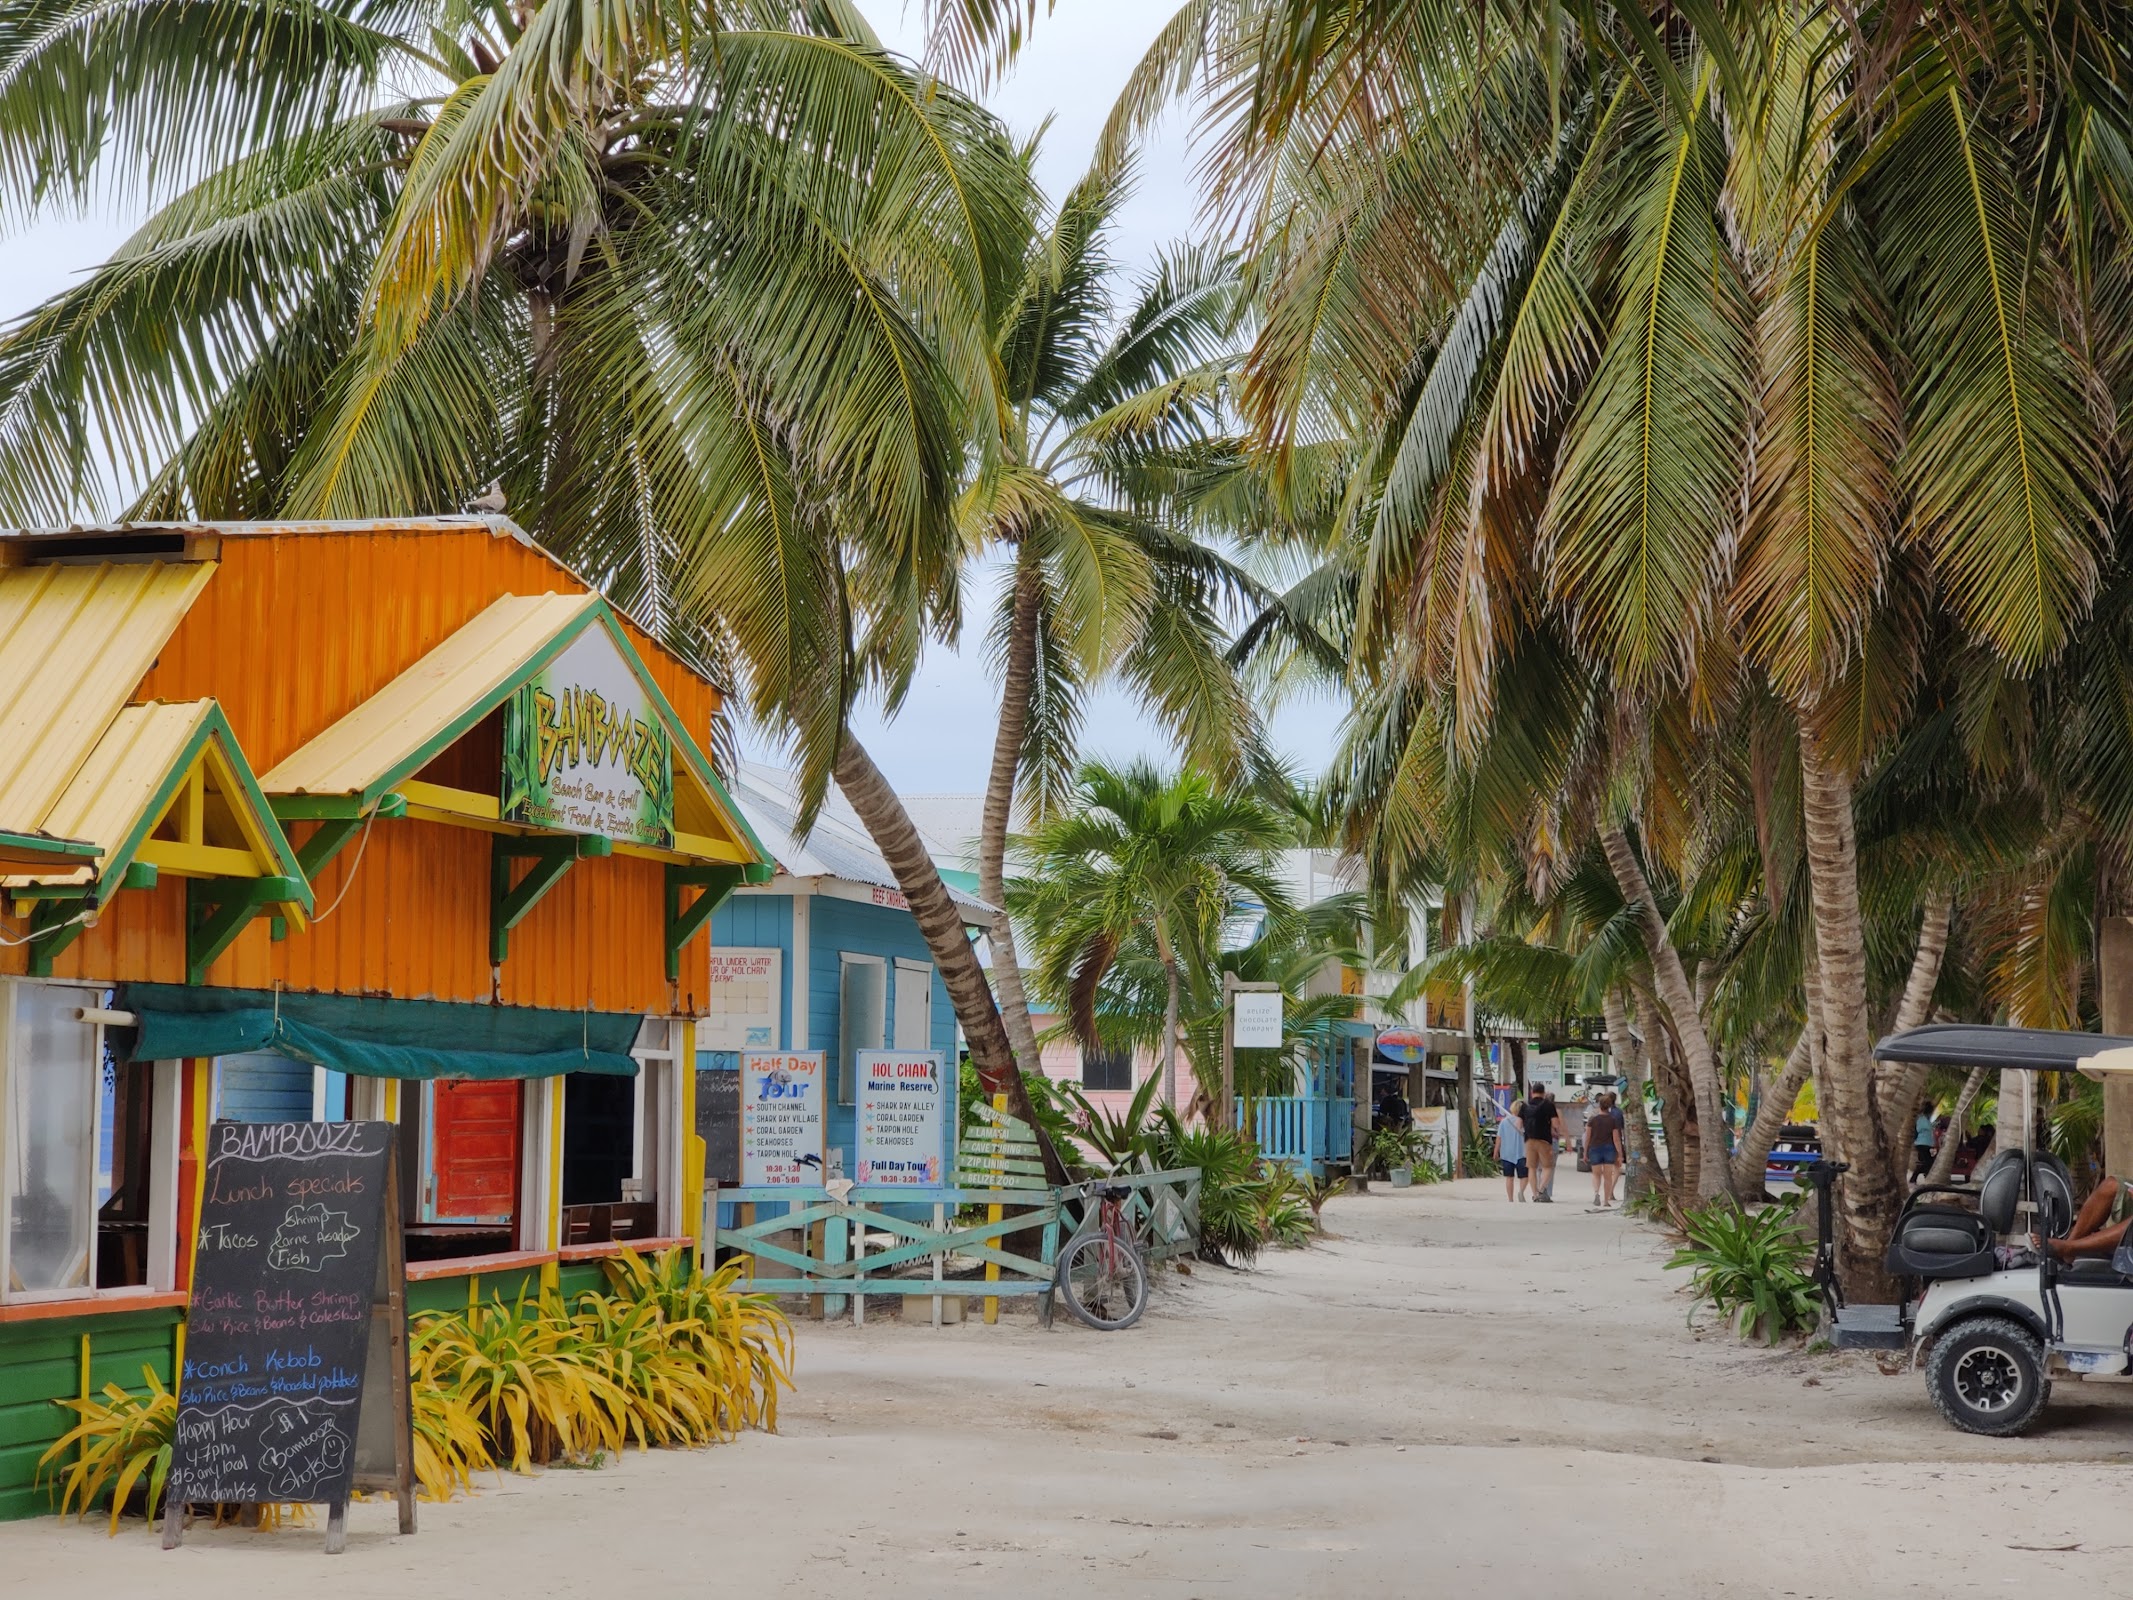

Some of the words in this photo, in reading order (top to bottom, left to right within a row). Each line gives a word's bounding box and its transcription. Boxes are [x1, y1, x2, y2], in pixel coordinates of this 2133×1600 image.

[535, 683, 664, 809] BAMBOOZE
[552, 776, 582, 799] Beach
[585, 783, 604, 803] Bar
[605, 789, 615, 809] &
[618, 789, 641, 811] Grill
[521, 794, 566, 823] Excellent
[568, 806, 595, 828] Food
[594, 813, 604, 832] &
[607, 812, 633, 836] Exotic
[636, 818, 665, 841] Drinks
[872, 887, 885, 904] REEF
[886, 891, 911, 909] SNORKEL
[726, 957, 748, 966] UNDER
[750, 957, 772, 967] WATER
[721, 966, 730, 975] OF
[731, 966, 746, 975] HOL
[746, 966, 767, 975] CHAN
[750, 1057, 782, 1072] Half
[787, 1057, 817, 1075] Day
[872, 1063, 894, 1078] HOL
[897, 1063, 928, 1078] CHAN
[757, 1077, 810, 1099] Tour
[868, 1081, 896, 1091] Marine
[900, 1081, 933, 1092] Reserve
[756, 1103, 777, 1111] SOUTH
[778, 1103, 807, 1111] CHANNEL
[876, 1102, 898, 1111] SHARK
[899, 1102, 911, 1111] RAY
[913, 1102, 935, 1111] ALLEY
[756, 1115, 777, 1123] SHARK
[779, 1115, 791, 1123] RAY
[792, 1115, 819, 1123] VILLAGE
[877, 1113, 897, 1122] CORAL
[899, 1113, 925, 1122] GARDEN
[756, 1126, 777, 1135] CORAL
[778, 1126, 803, 1135] GARDEN
[877, 1125, 901, 1134] TARPON
[902, 1125, 919, 1134] HOLE
[221, 1122, 366, 1156] BAMBOOZE
[756, 1138, 794, 1146] SEAHORSES
[876, 1137, 914, 1146] SEAHORSES
[756, 1150, 780, 1158] TARPON
[781, 1150, 798, 1158] HOLE
[972, 1143, 990, 1153] CAVE
[766, 1165, 783, 1173] 10:30
[788, 1165, 801, 1173] 1:30
[871, 1161, 887, 1171] Full
[889, 1161, 905, 1172] Day
[907, 1161, 927, 1171] Tour
[967, 1158, 982, 1167] ZIP
[983, 1159, 1010, 1170] LINING
[209, 1164, 273, 1205] Lunch
[766, 1176, 781, 1184] 2:00
[785, 1176, 800, 1184] 5:00
[881, 1175, 898, 1183] 10:30
[903, 1175, 917, 1183] 3:30
[968, 1174, 996, 1184] BELIZE
[997, 1176, 1015, 1186] ZOO
[317, 1226, 351, 1243] Asada
[277, 1248, 310, 1267] Fish
[254, 1289, 304, 1312] Butter
[220, 1316, 251, 1335] Rice
[263, 1315, 295, 1330] Beans
[265, 1344, 322, 1371] Kebob
[203, 1386, 229, 1403] Rice
[238, 1383, 268, 1397] Beans
[177, 1418, 216, 1445] Happy
[222, 1409, 254, 1436] Hour
[197, 1464, 220, 1480] any
[223, 1454, 249, 1475] local
[211, 1478, 257, 1503] drinks
